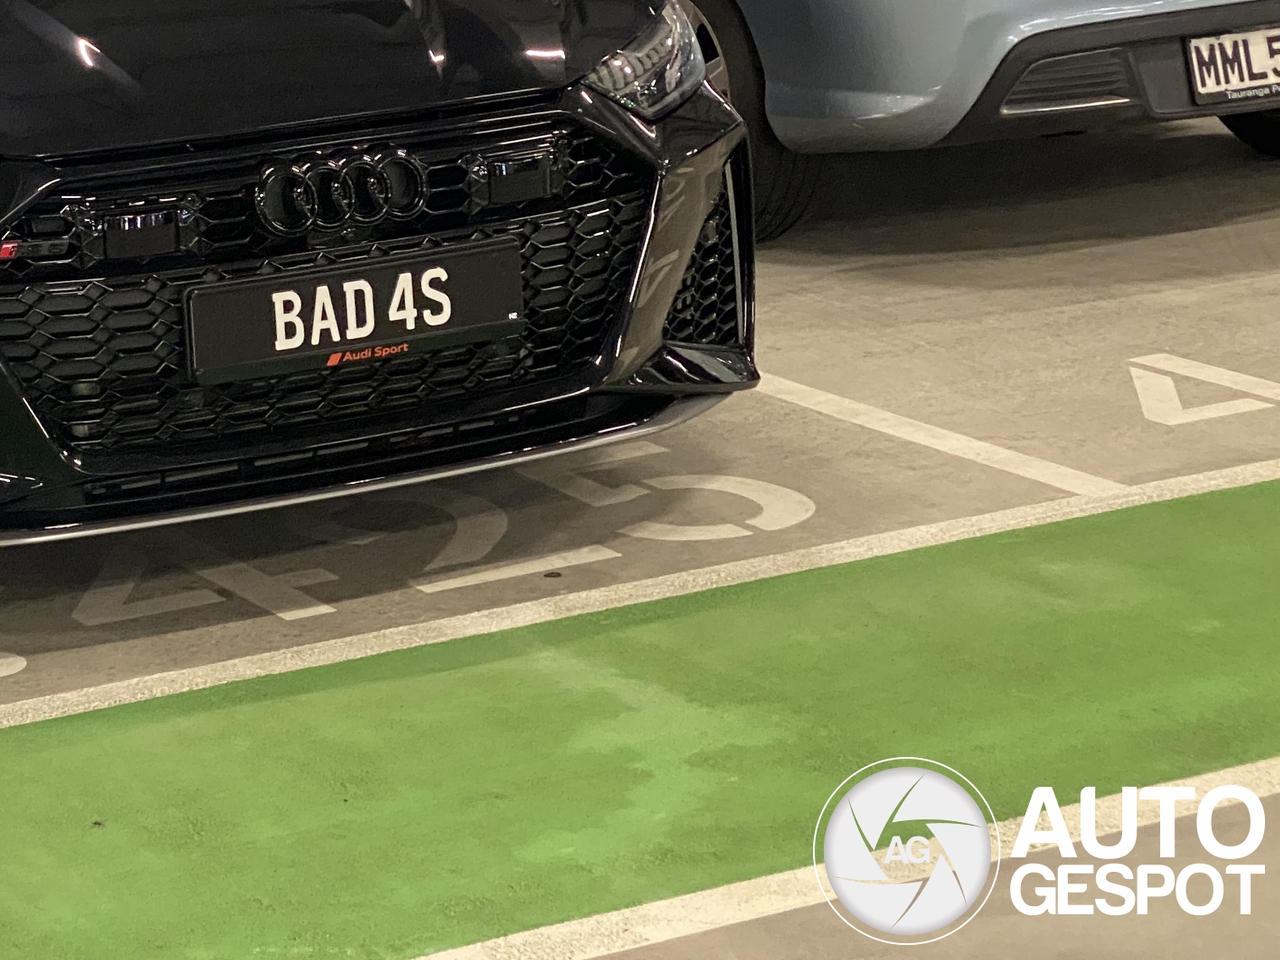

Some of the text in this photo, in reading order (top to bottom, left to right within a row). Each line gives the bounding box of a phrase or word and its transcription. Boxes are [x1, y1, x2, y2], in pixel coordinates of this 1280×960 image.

[272, 267, 452, 351] BAD 4S
[342, 342, 409, 361] Audi Sport
